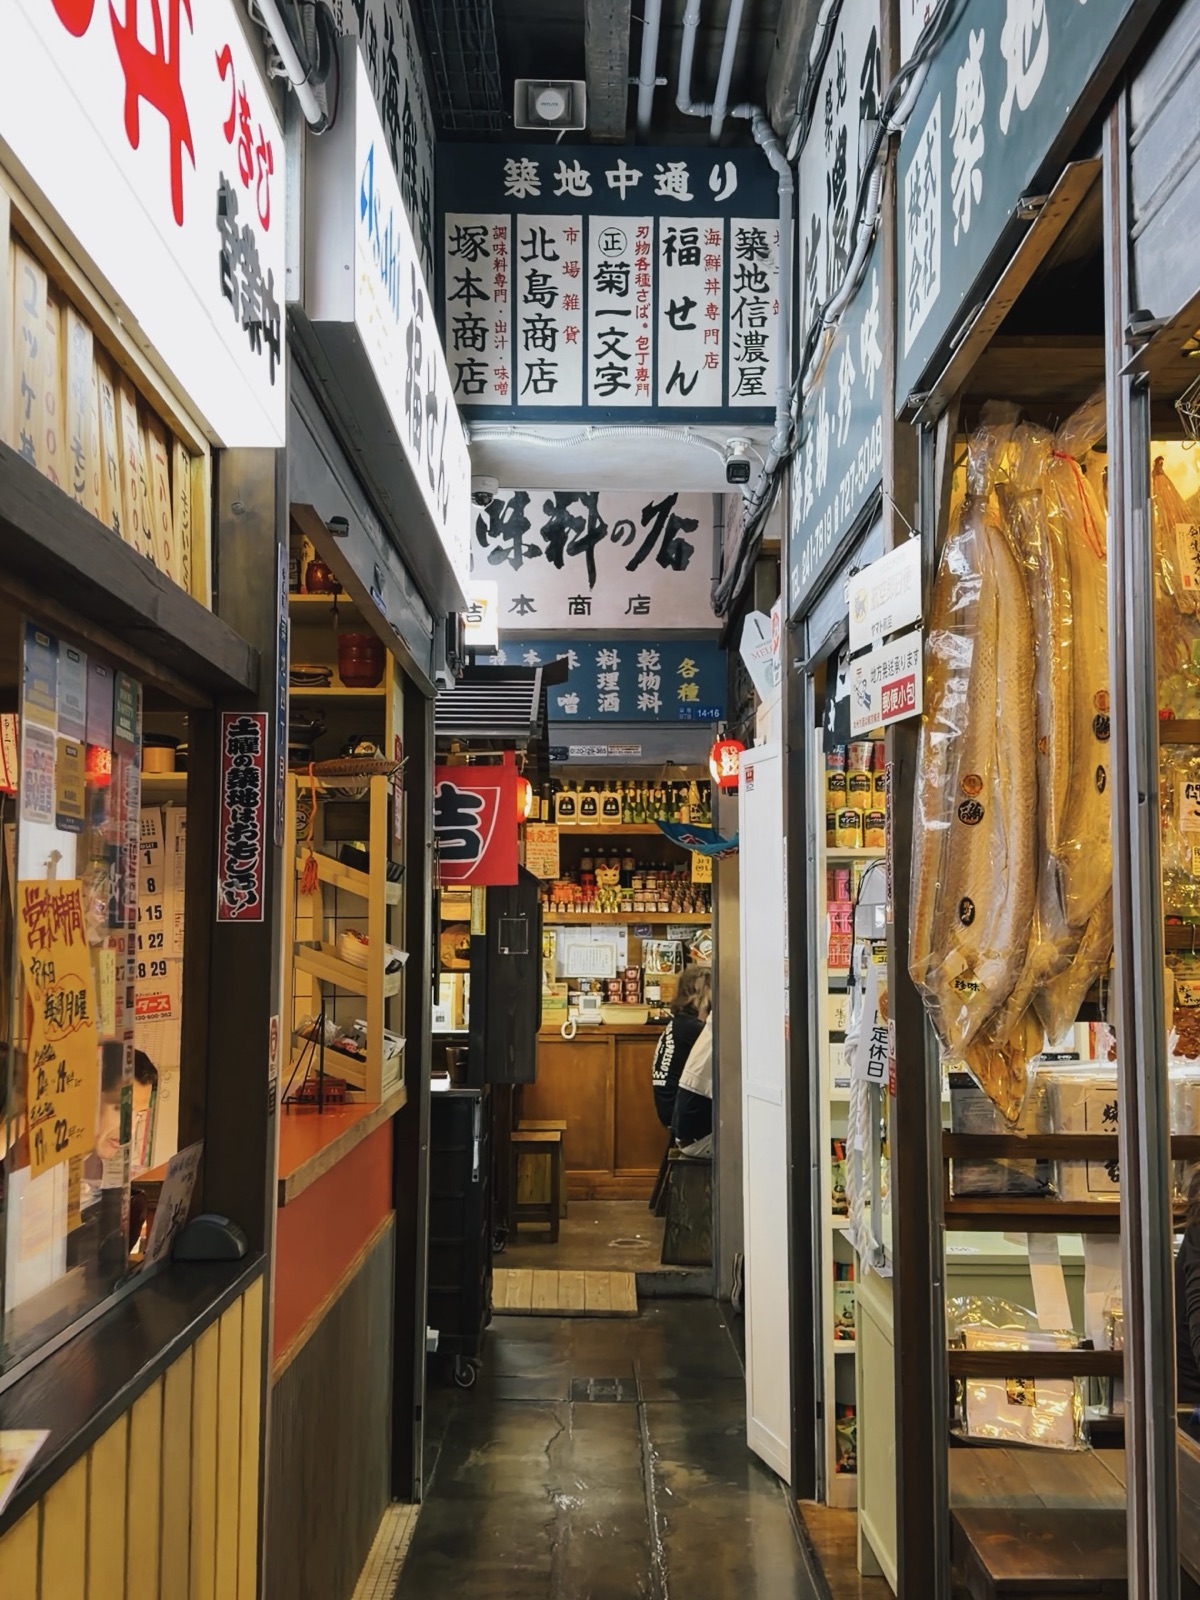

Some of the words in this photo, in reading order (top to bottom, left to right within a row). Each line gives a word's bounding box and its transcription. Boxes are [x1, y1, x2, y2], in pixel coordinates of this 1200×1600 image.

[503, 157, 738, 202] 築地中通り
[447, 223, 491, 396] 塚本商店
[520, 225, 560, 396] 北島商店
[562, 226, 581, 345] 市場雑貨
[662, 226, 701, 396] 福せん
[703, 227, 722, 370] 海鮮丼専門店
[731, 226, 771, 397] 築地信濃屋
[839, 414, 883, 524] 727-5048
[472, 491, 699, 590] 味料の店
[595, 648, 621, 713] 料理酒
[676, 657, 700, 703] 各種
[882, 681, 915, 715] 郵便小包
[144, 851, 152, 864] 1
[147, 878, 156, 892] 8
[145, 905, 163, 920] 15
[148, 933, 164, 949] 22
[150, 961, 167, 977] 29
[954, 980, 980, 992] 珍味
